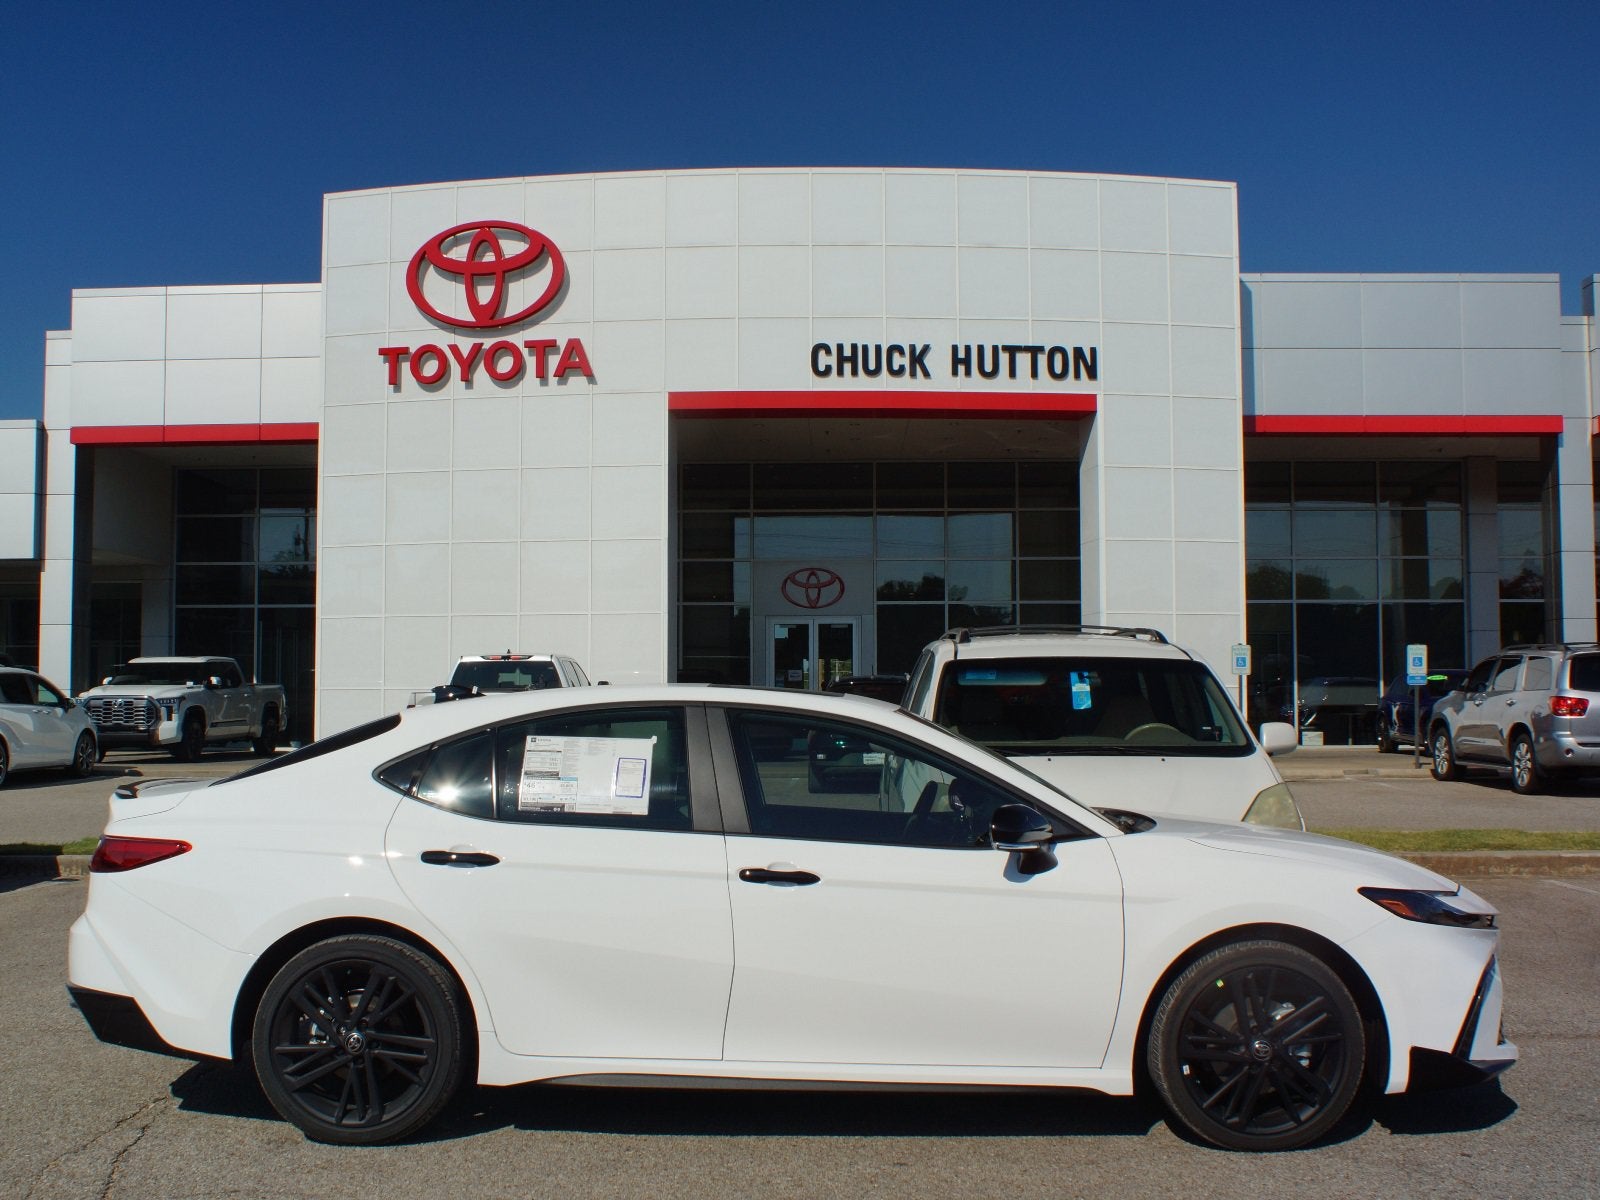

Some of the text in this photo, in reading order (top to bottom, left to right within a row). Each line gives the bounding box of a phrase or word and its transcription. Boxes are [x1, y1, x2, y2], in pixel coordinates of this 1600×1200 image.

[378, 338, 594, 386] TOYOTA
[810, 342, 1098, 380] CHUCK HUTTON
